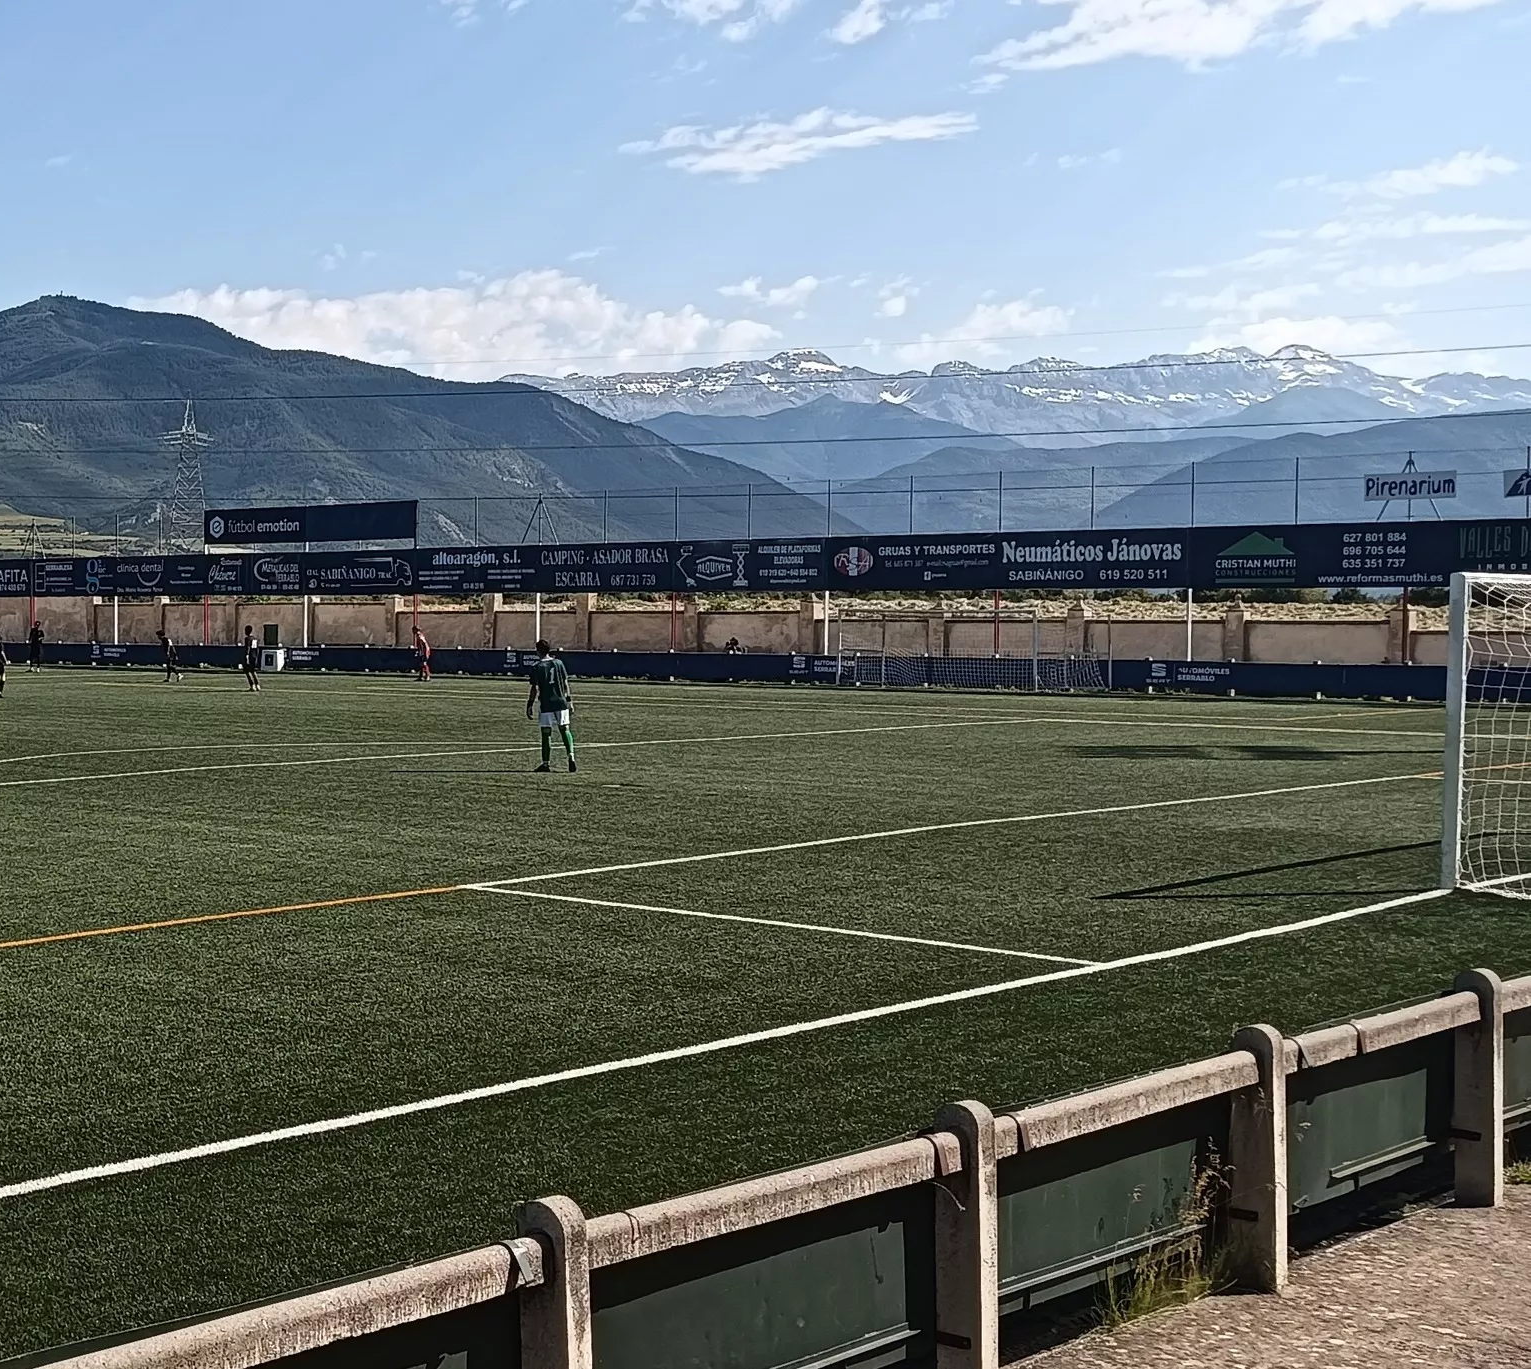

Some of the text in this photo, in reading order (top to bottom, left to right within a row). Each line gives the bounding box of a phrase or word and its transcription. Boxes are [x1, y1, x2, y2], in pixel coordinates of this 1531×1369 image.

[1365, 475, 1456, 497] Pirenarium
[228, 518, 300, 533] fútbol emotion
[1343, 532, 1407, 543] 627 801 884
[1460, 526, 1511, 558] VALLES
[878, 544, 996, 556] GRUAS Y TRANSPORTES
[1002, 537, 1182, 564] Neumáticos Jánovas
[1365, 546, 1383, 555] 705
[541, 550, 585, 566] CAMPING
[591, 549, 632, 565] ASADOR
[634, 548, 669, 564] BRASA
[1215, 558, 1297, 569] CRISTIAN MUTHI
[1342, 558, 1406, 568] 635 351 737
[117, 563, 139, 573] clínica
[141, 559, 164, 572] dental
[555, 571, 601, 587] ESCARRA
[1009, 568, 1168, 581] SABIÑÁNIGO 619 520 511
[1318, 572, 1444, 584] www.reformasmuthi.es
[549, 667, 555, 684] 1
[1177, 674, 1216, 682] SERRABLO
